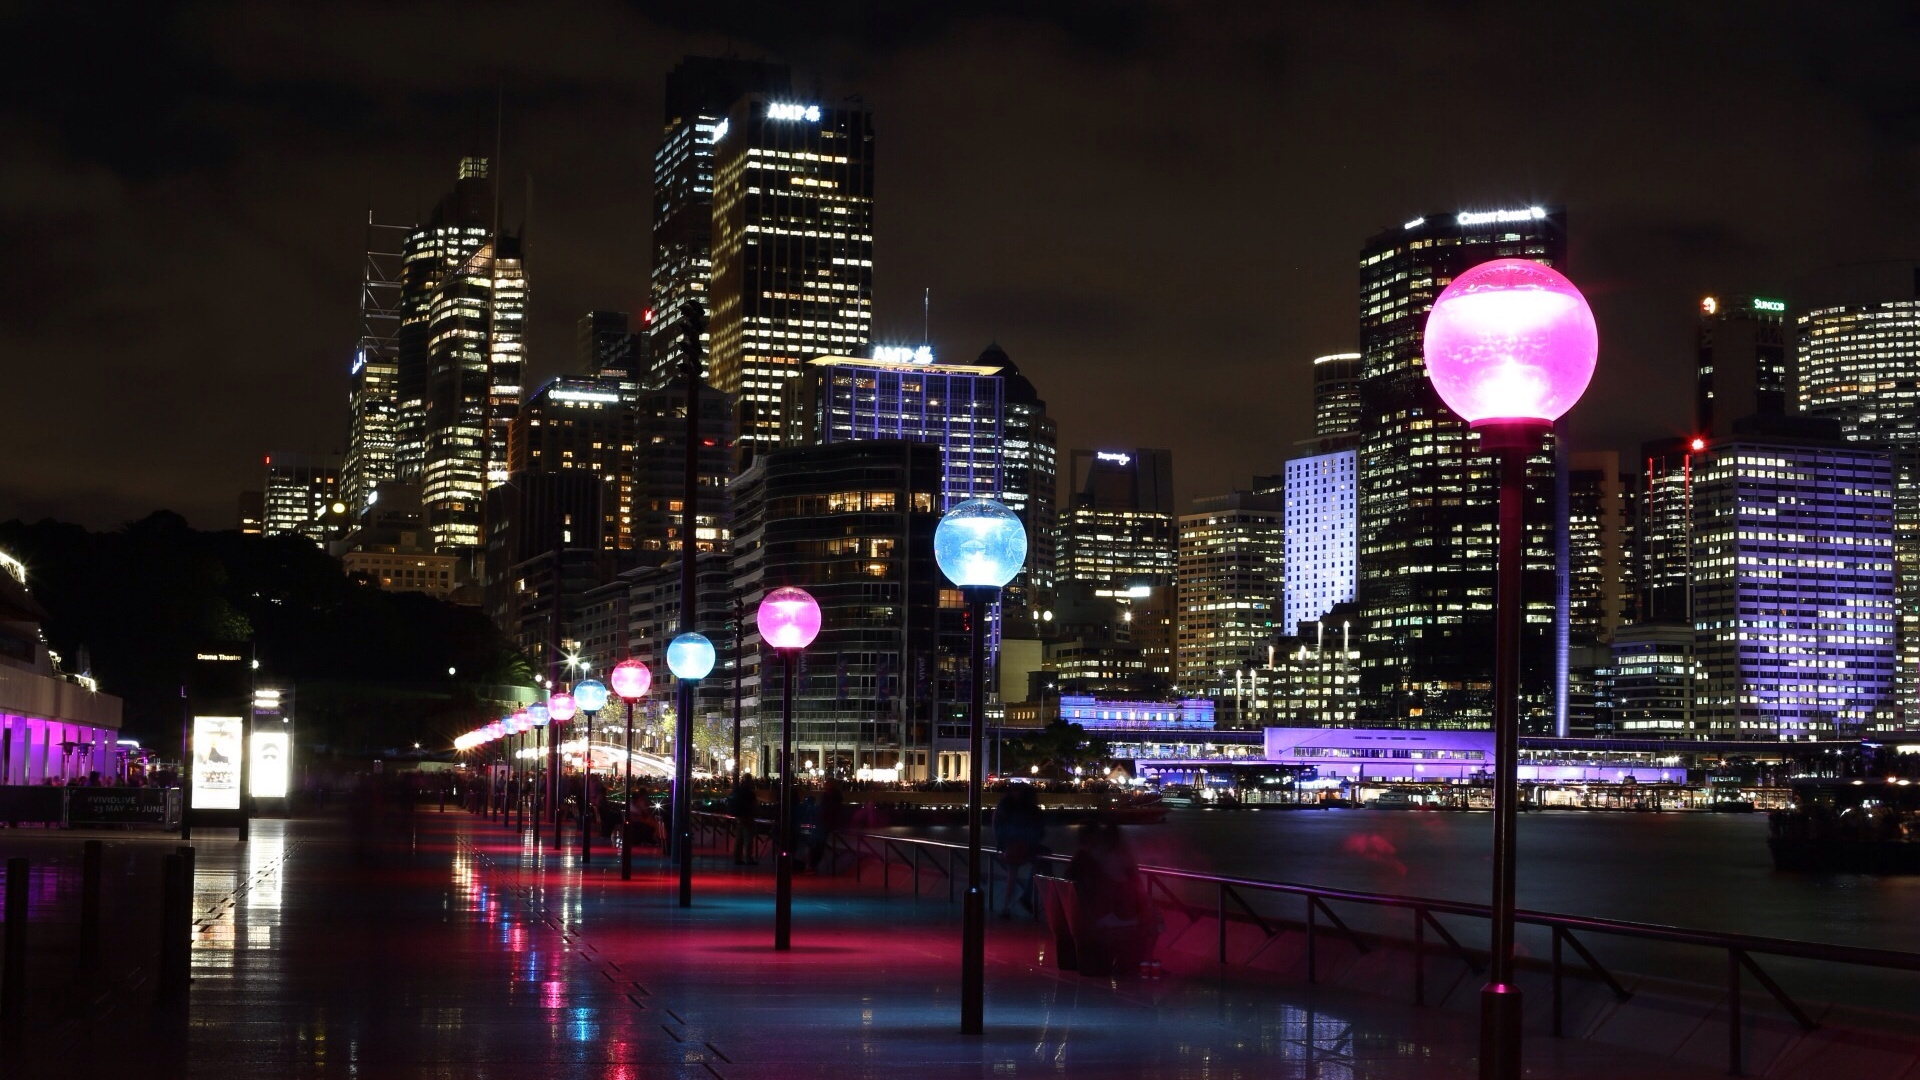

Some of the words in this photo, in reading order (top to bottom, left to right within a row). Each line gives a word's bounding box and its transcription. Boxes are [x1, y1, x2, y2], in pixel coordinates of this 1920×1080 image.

[767, 103, 806, 120] AMP
[1754, 298, 1785, 311] SUNCOR
[873, 346, 914, 363] AMP
[218, 653, 242, 661] Theatre
[105, 805, 125, 813] MAY
[142, 805, 165, 813] JUNE
